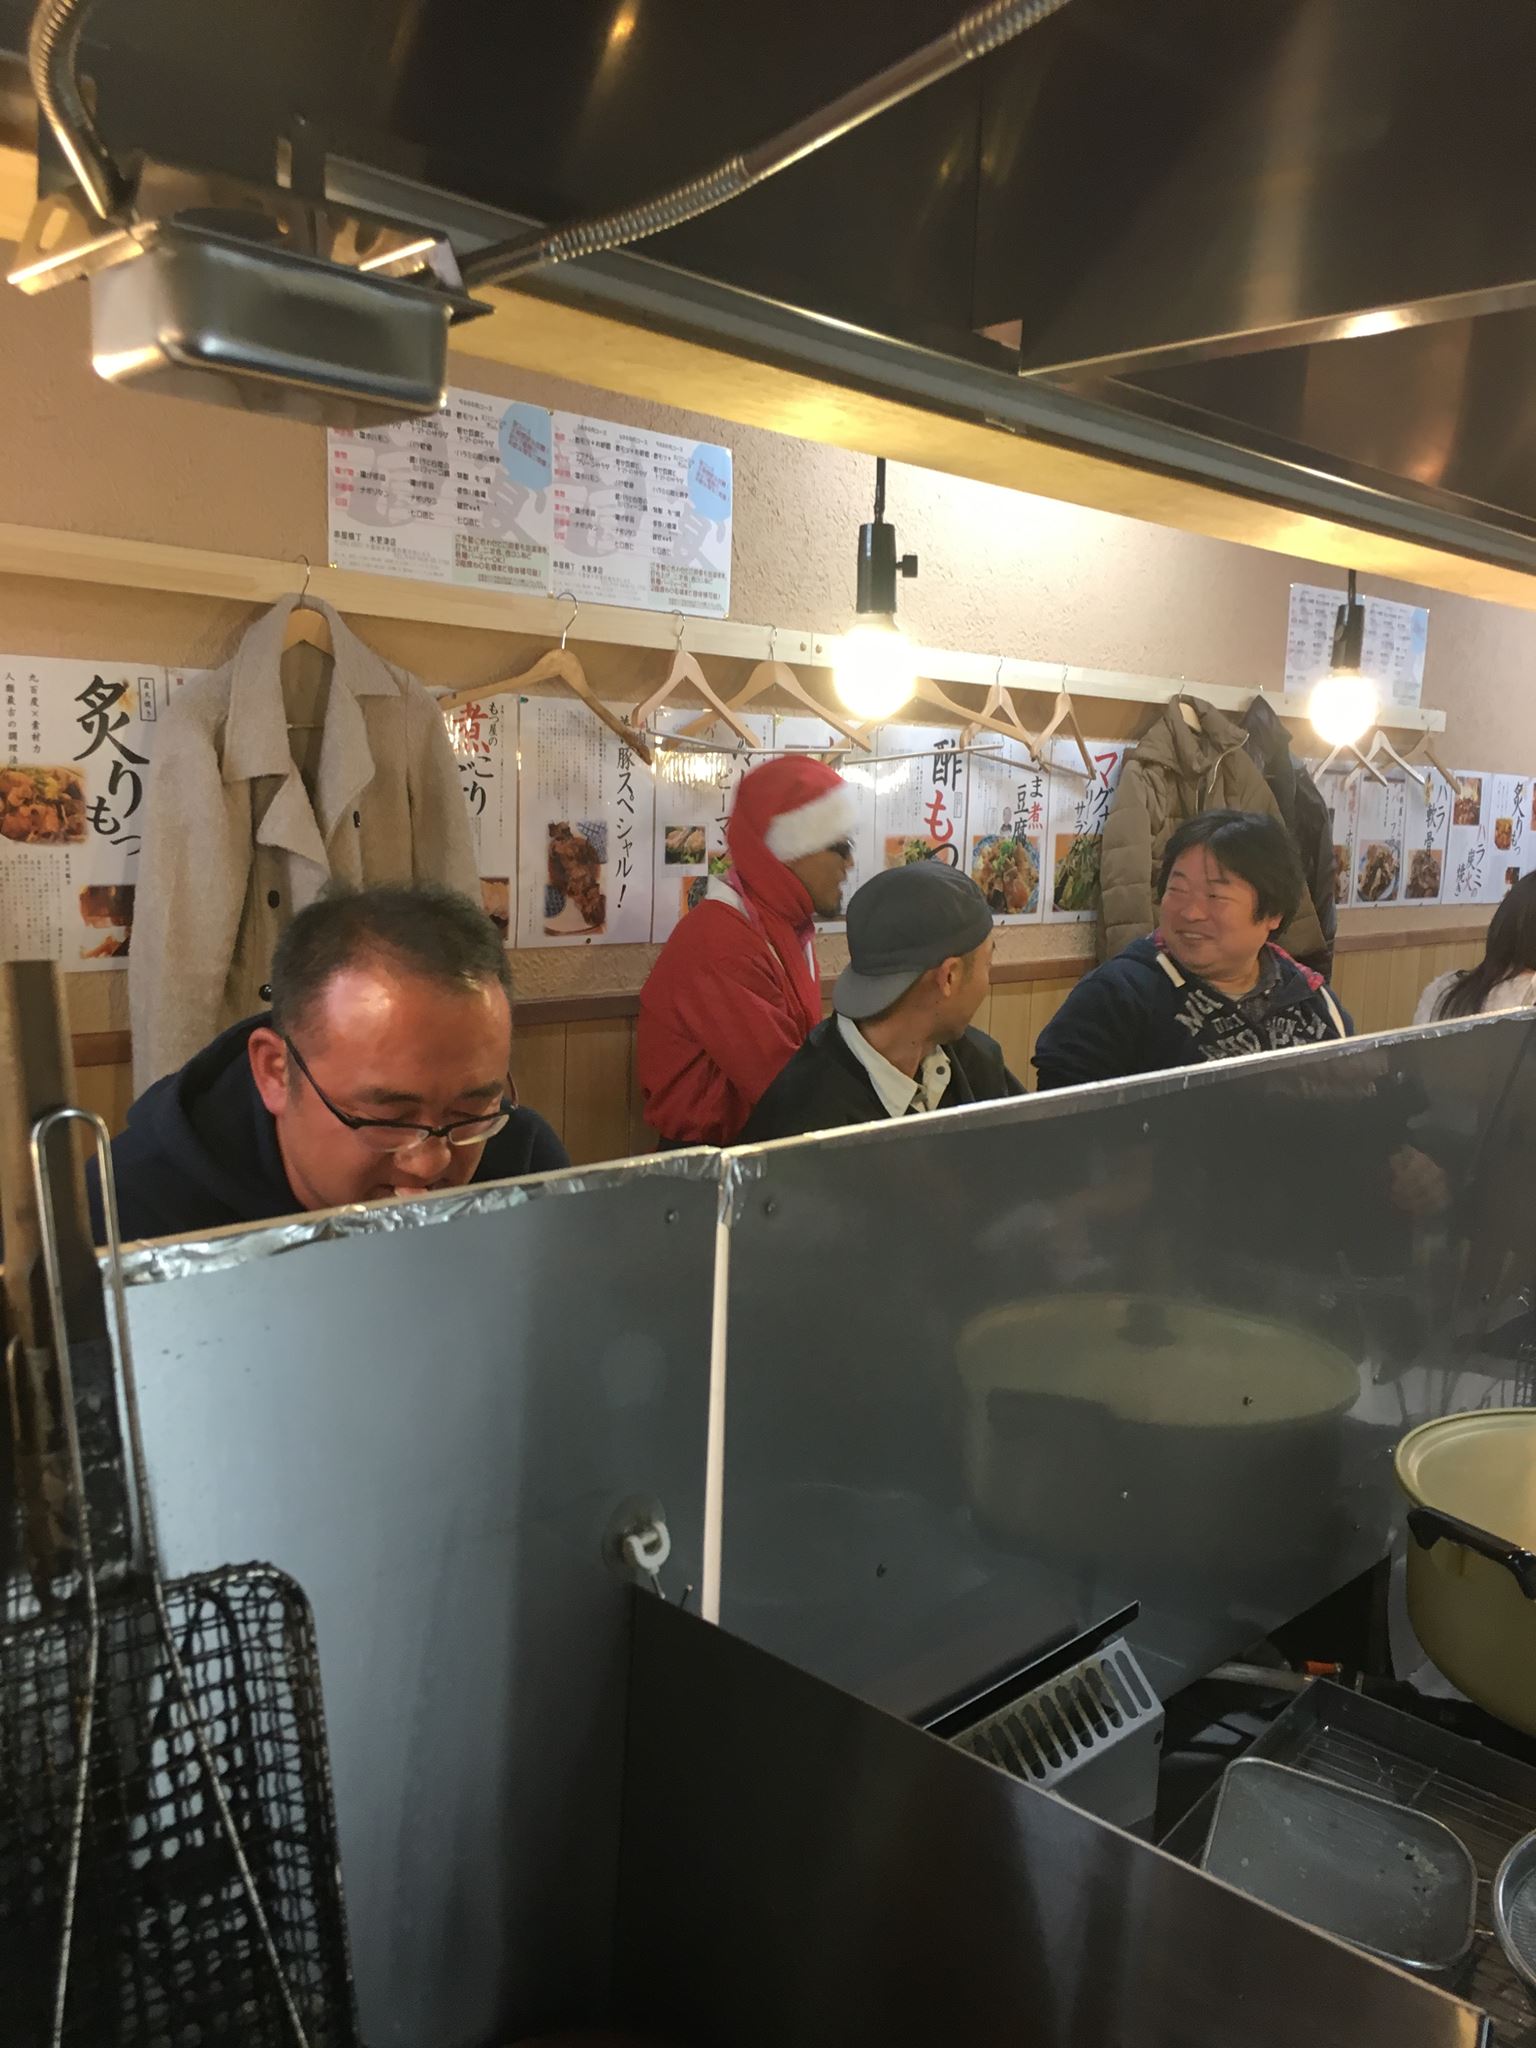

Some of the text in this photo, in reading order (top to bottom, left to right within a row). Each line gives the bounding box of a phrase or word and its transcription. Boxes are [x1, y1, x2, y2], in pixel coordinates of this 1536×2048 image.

[5, 672, 18, 764] 人類最古の調理法
[28, 673, 41, 754] 九百度×素材力
[488, 702, 500, 747] もつ屋の
[615, 715, 636, 908] 豚スペシャル！
[715, 768, 733, 846] ピーマ
[924, 739, 963, 868] 酢もつ
[1028, 766, 1044, 830] ま煮
[1084, 779, 1094, 837] リーン
[1510, 782, 1525, 856] 炙りもつ
